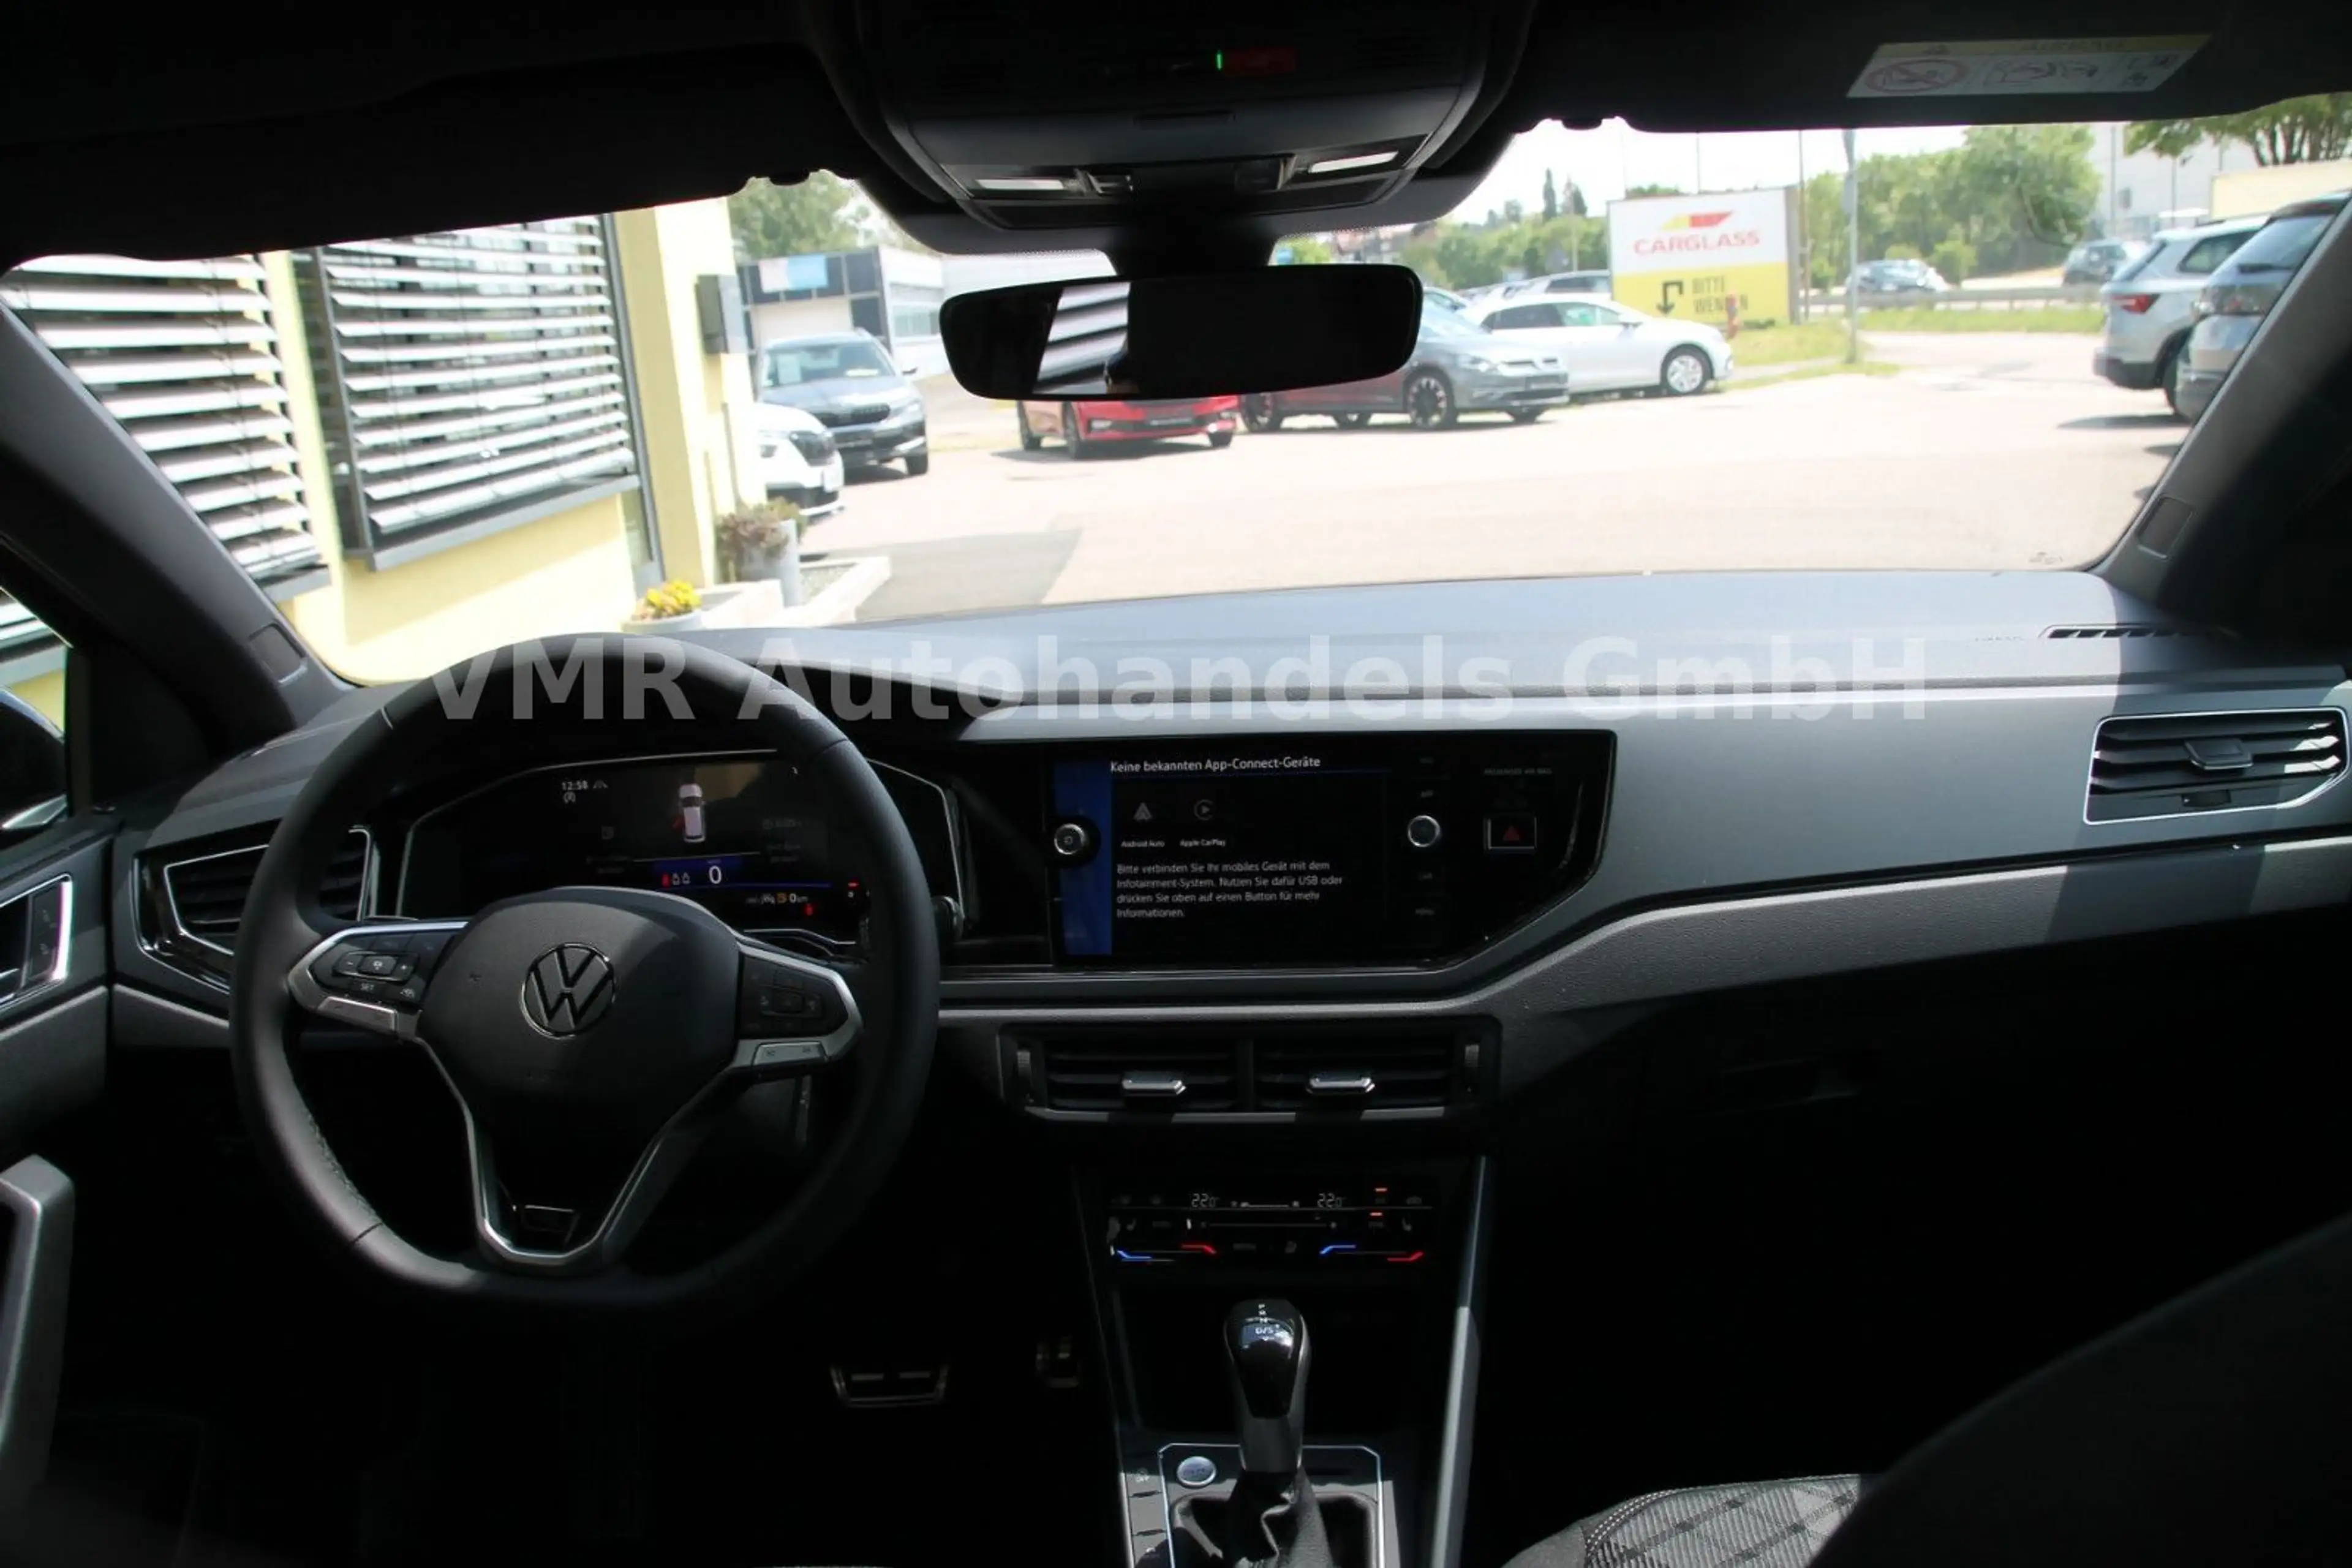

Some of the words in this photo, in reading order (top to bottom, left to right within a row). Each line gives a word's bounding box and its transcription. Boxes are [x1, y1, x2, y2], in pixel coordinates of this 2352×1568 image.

[1634, 229, 1760, 255] CARGLASS
[1692, 293, 1749, 314] WENN
[1110, 761, 1141, 774] Keine
[1144, 760, 1202, 772] bekannten
[1205, 756, 1321, 772] App-Connect-Geräte
[707, 865, 723, 884] 0
[1117, 864, 1139, 874] Bitte
[1141, 863, 1188, 873] verbinden
[1190, 862, 1205, 872] Sie
[1207, 862, 1219, 872] Ihr
[1221, 862, 1259, 872] mobiles
[1261, 861, 1287, 871] Gerät
[1289, 861, 1306, 870] mit
[1308, 861, 1330, 870] dem
[1218, 876, 1252, 887] Nutzen
[1254, 876, 1269, 886] Sie
[1271, 876, 1295, 886] dafür
[1297, 875, 1318, 886] USB
[1320, 875, 1343, 885] oder
[1117, 894, 1153, 903] drücken
[1155, 892, 1170, 903] Sie
[1171, 893, 1196, 903] oben
[1198, 892, 1213, 903] auf
[1215, 892, 1242, 902] einen
[1245, 891, 1277, 902] Button
[1279, 891, 1292, 901] für
[1294, 890, 1320, 900] mehr
